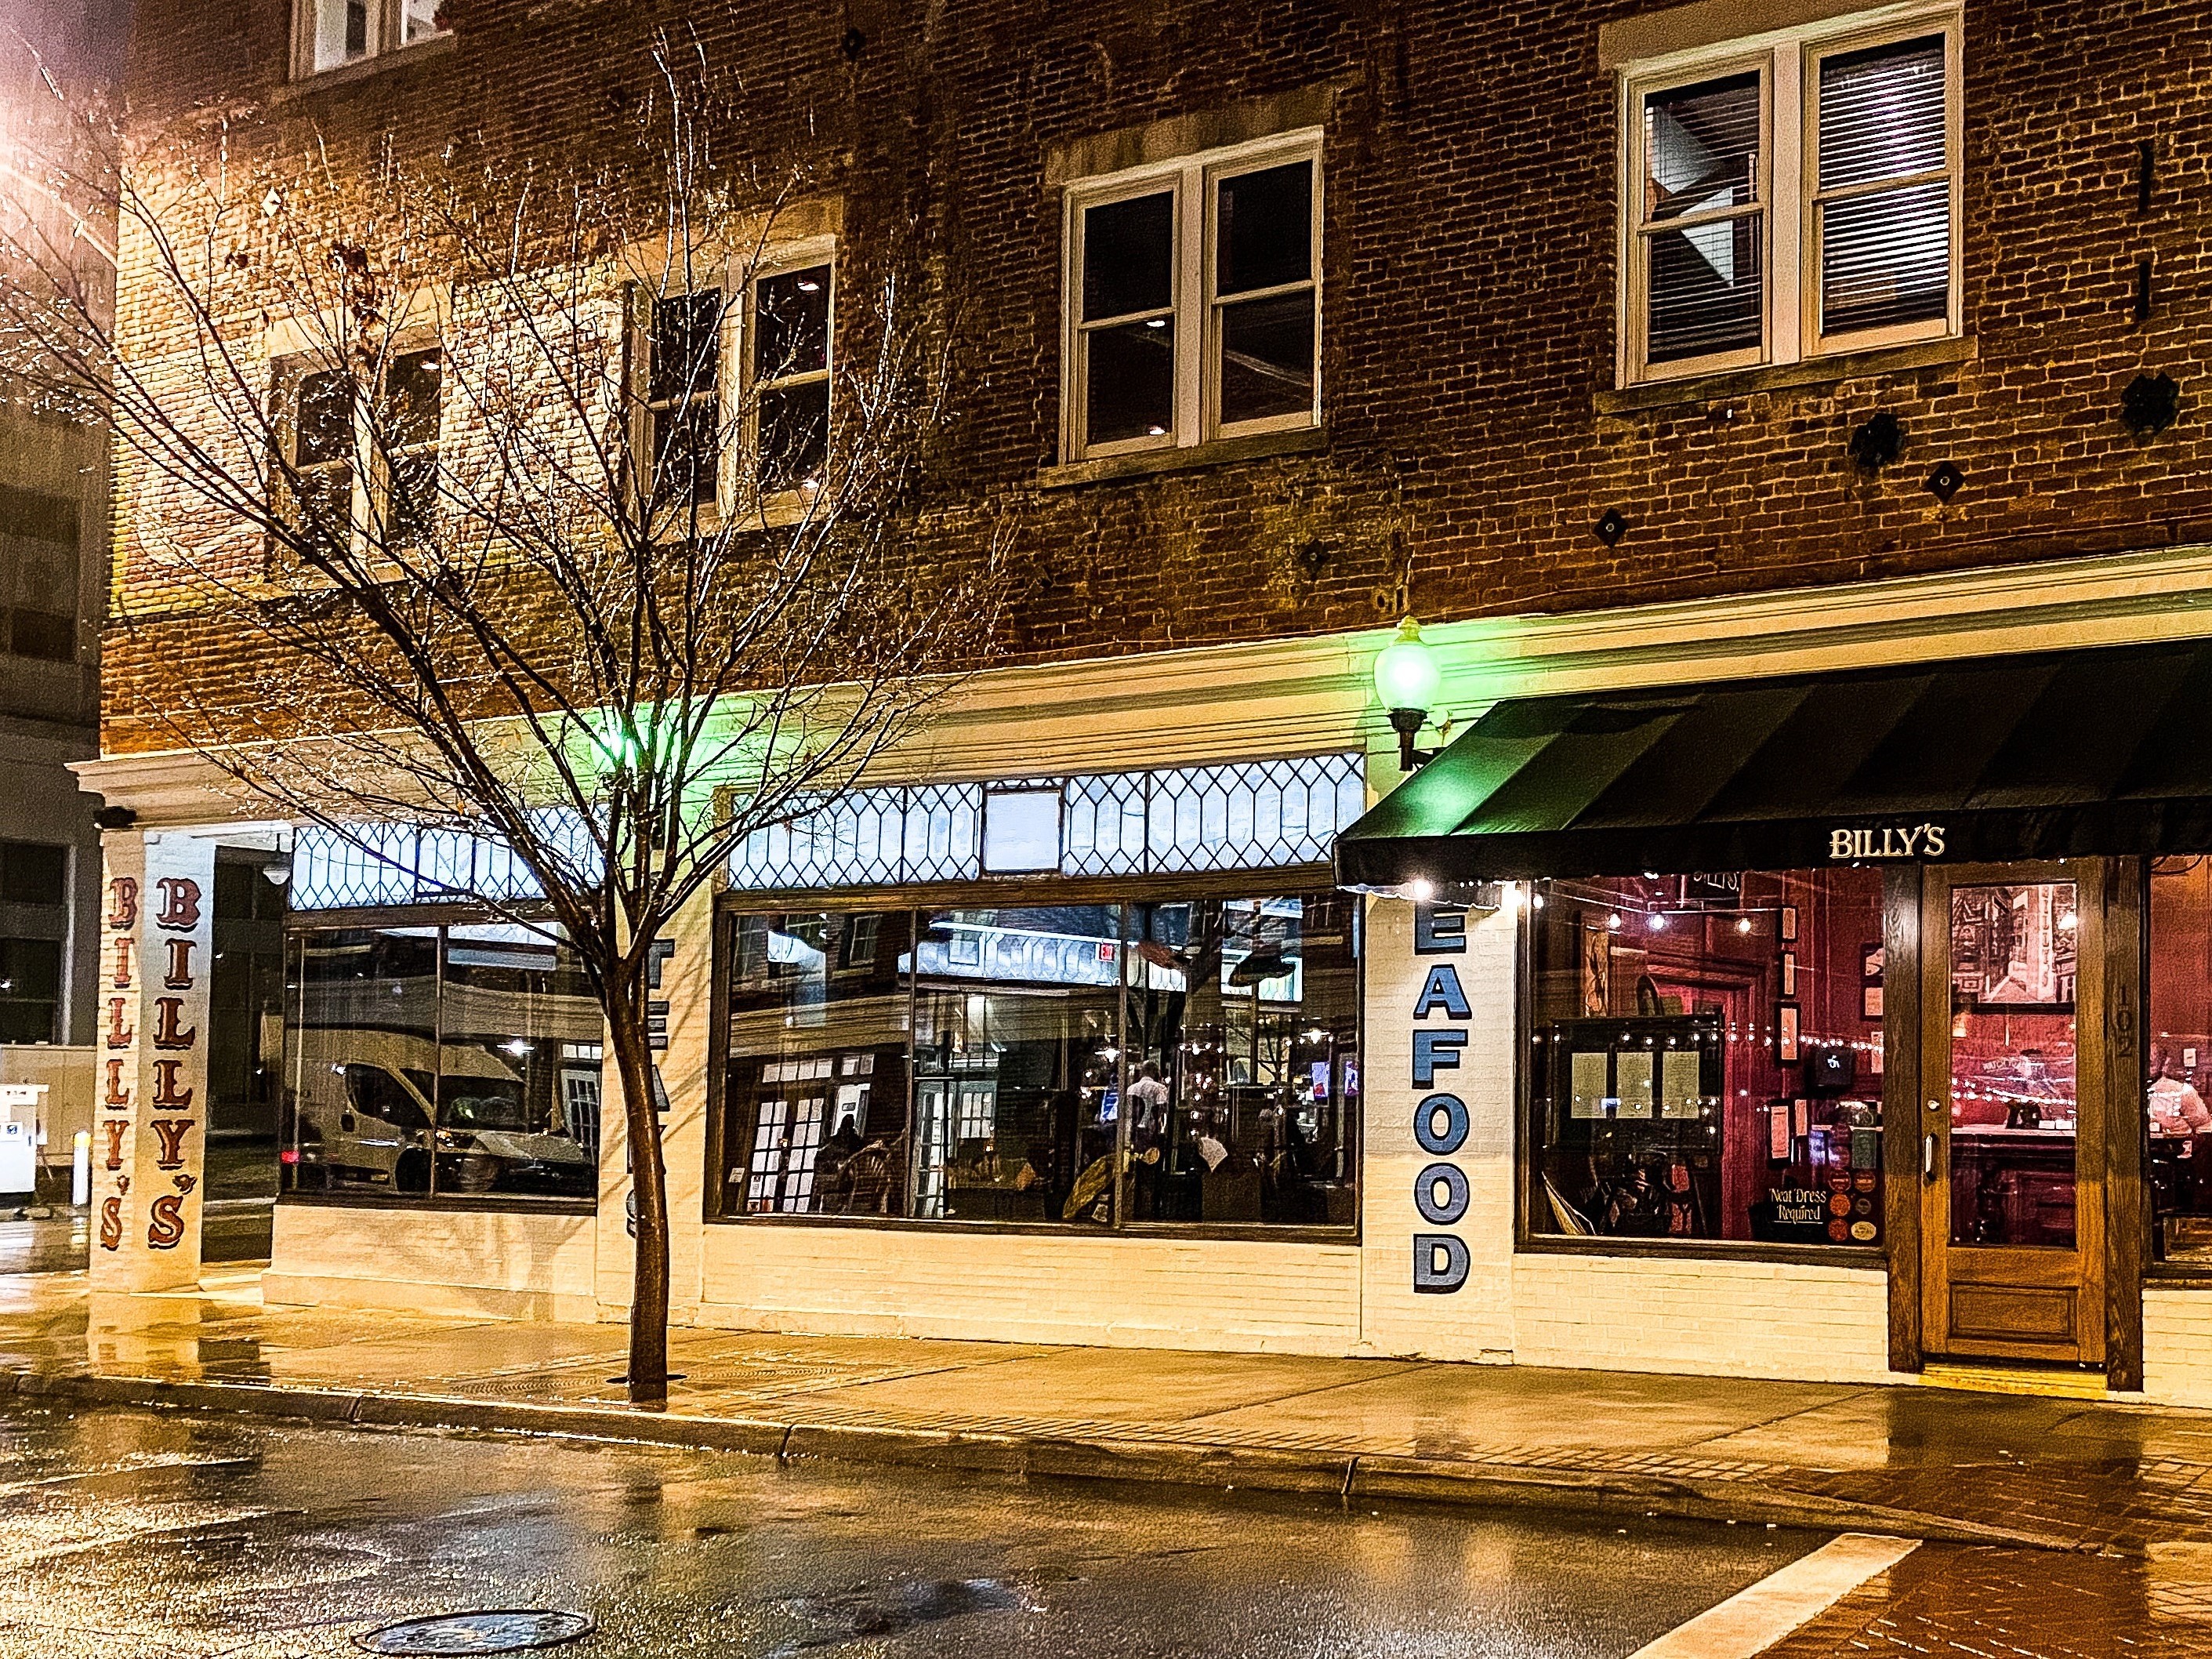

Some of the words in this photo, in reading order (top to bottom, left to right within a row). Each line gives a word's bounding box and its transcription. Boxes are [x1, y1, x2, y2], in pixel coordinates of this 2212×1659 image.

[1829, 823, 1945, 859] BILLY'S
[2116, 984, 2132, 1057] 102
[100, 877, 138, 1250] BILLY'S
[147, 877, 201, 1250] BILLY'S
[1411, 900, 1472, 1294] EAFOOD
[1769, 1189, 1793, 1203] Neat
[1793, 1189, 1827, 1203] Dress
[1776, 1204, 1821, 1224] Required
